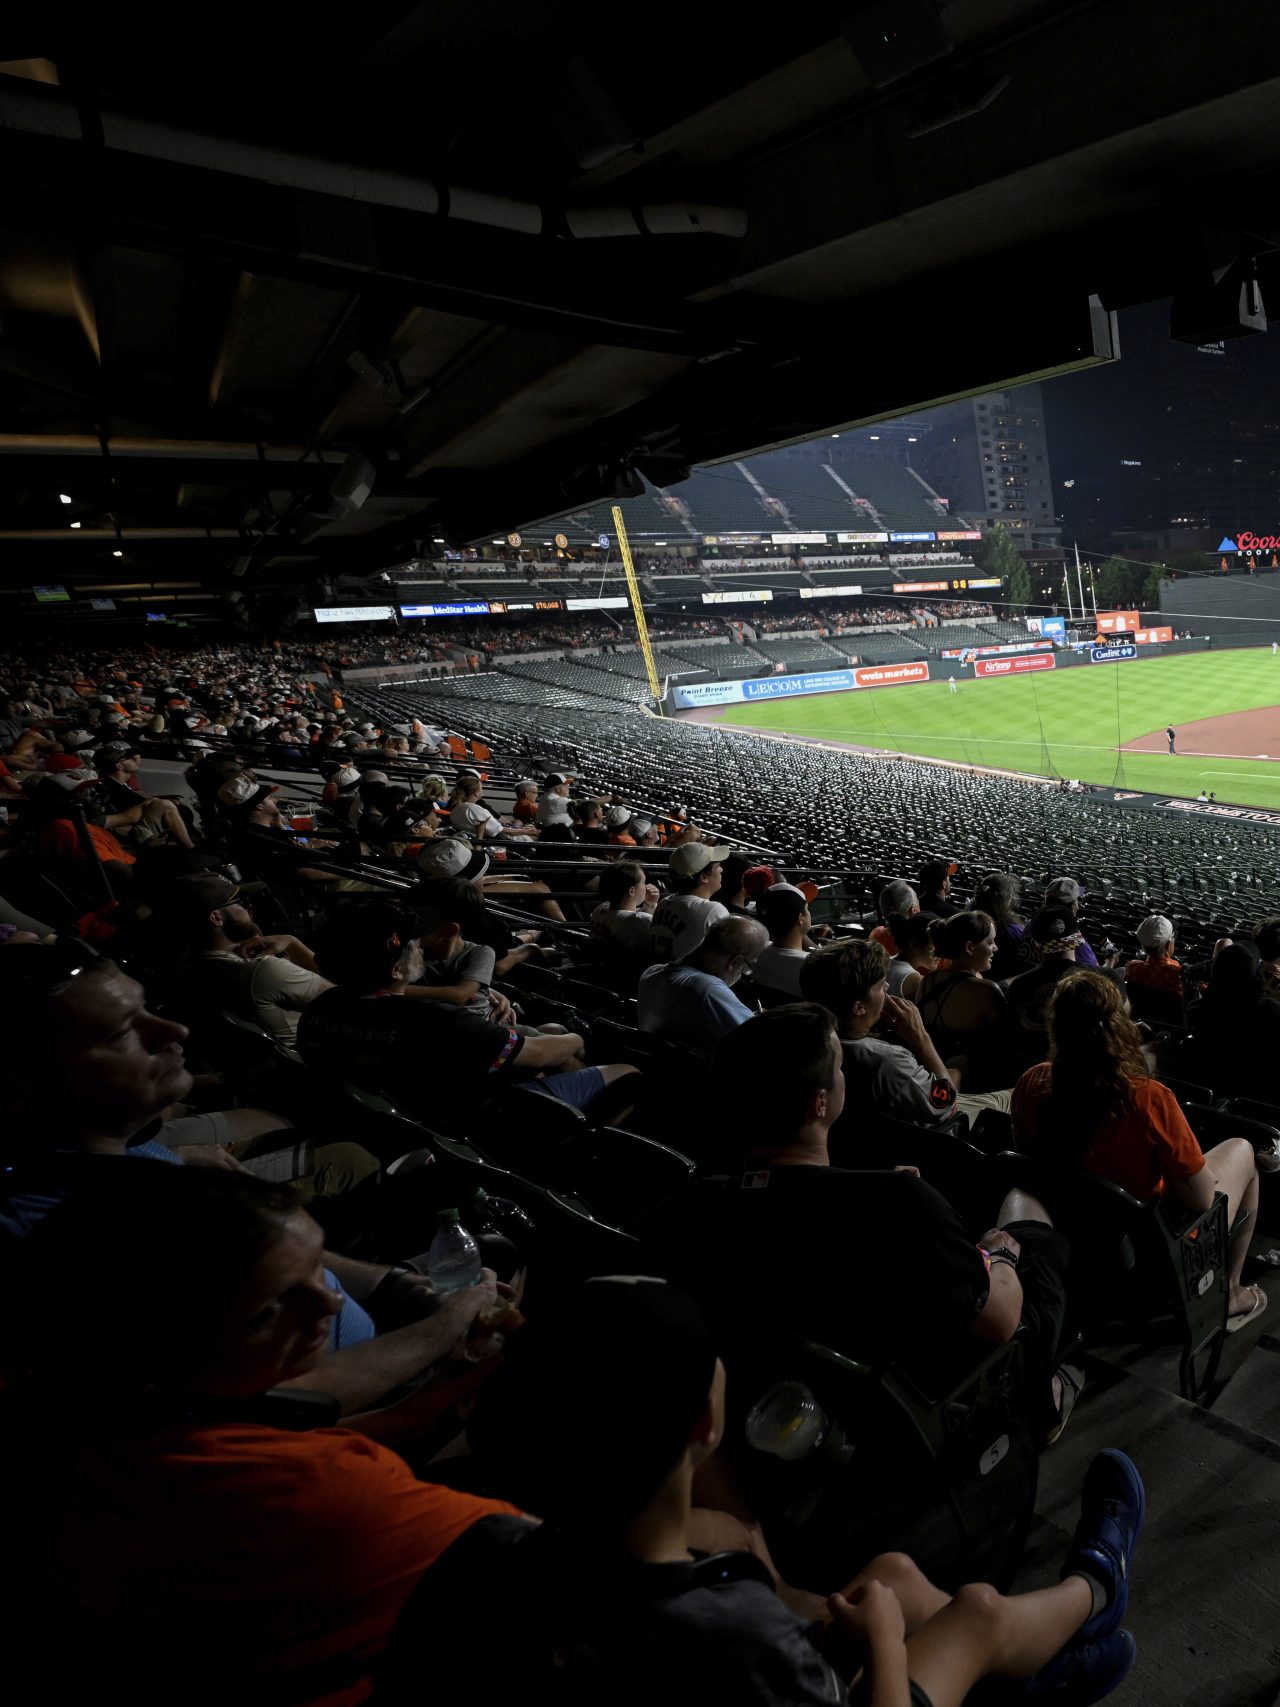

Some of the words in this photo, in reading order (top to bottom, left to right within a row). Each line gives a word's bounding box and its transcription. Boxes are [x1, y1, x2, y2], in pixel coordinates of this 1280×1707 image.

[434, 606, 463, 614] MedStar
[464, 605, 488, 613] Health
[861, 672, 884, 681] weis
[885, 666, 923, 678] markets
[1166, 800, 1246, 817] WELCOME
[1241, 812, 1270, 820] TO
[991, 1444, 999, 1464] 5
